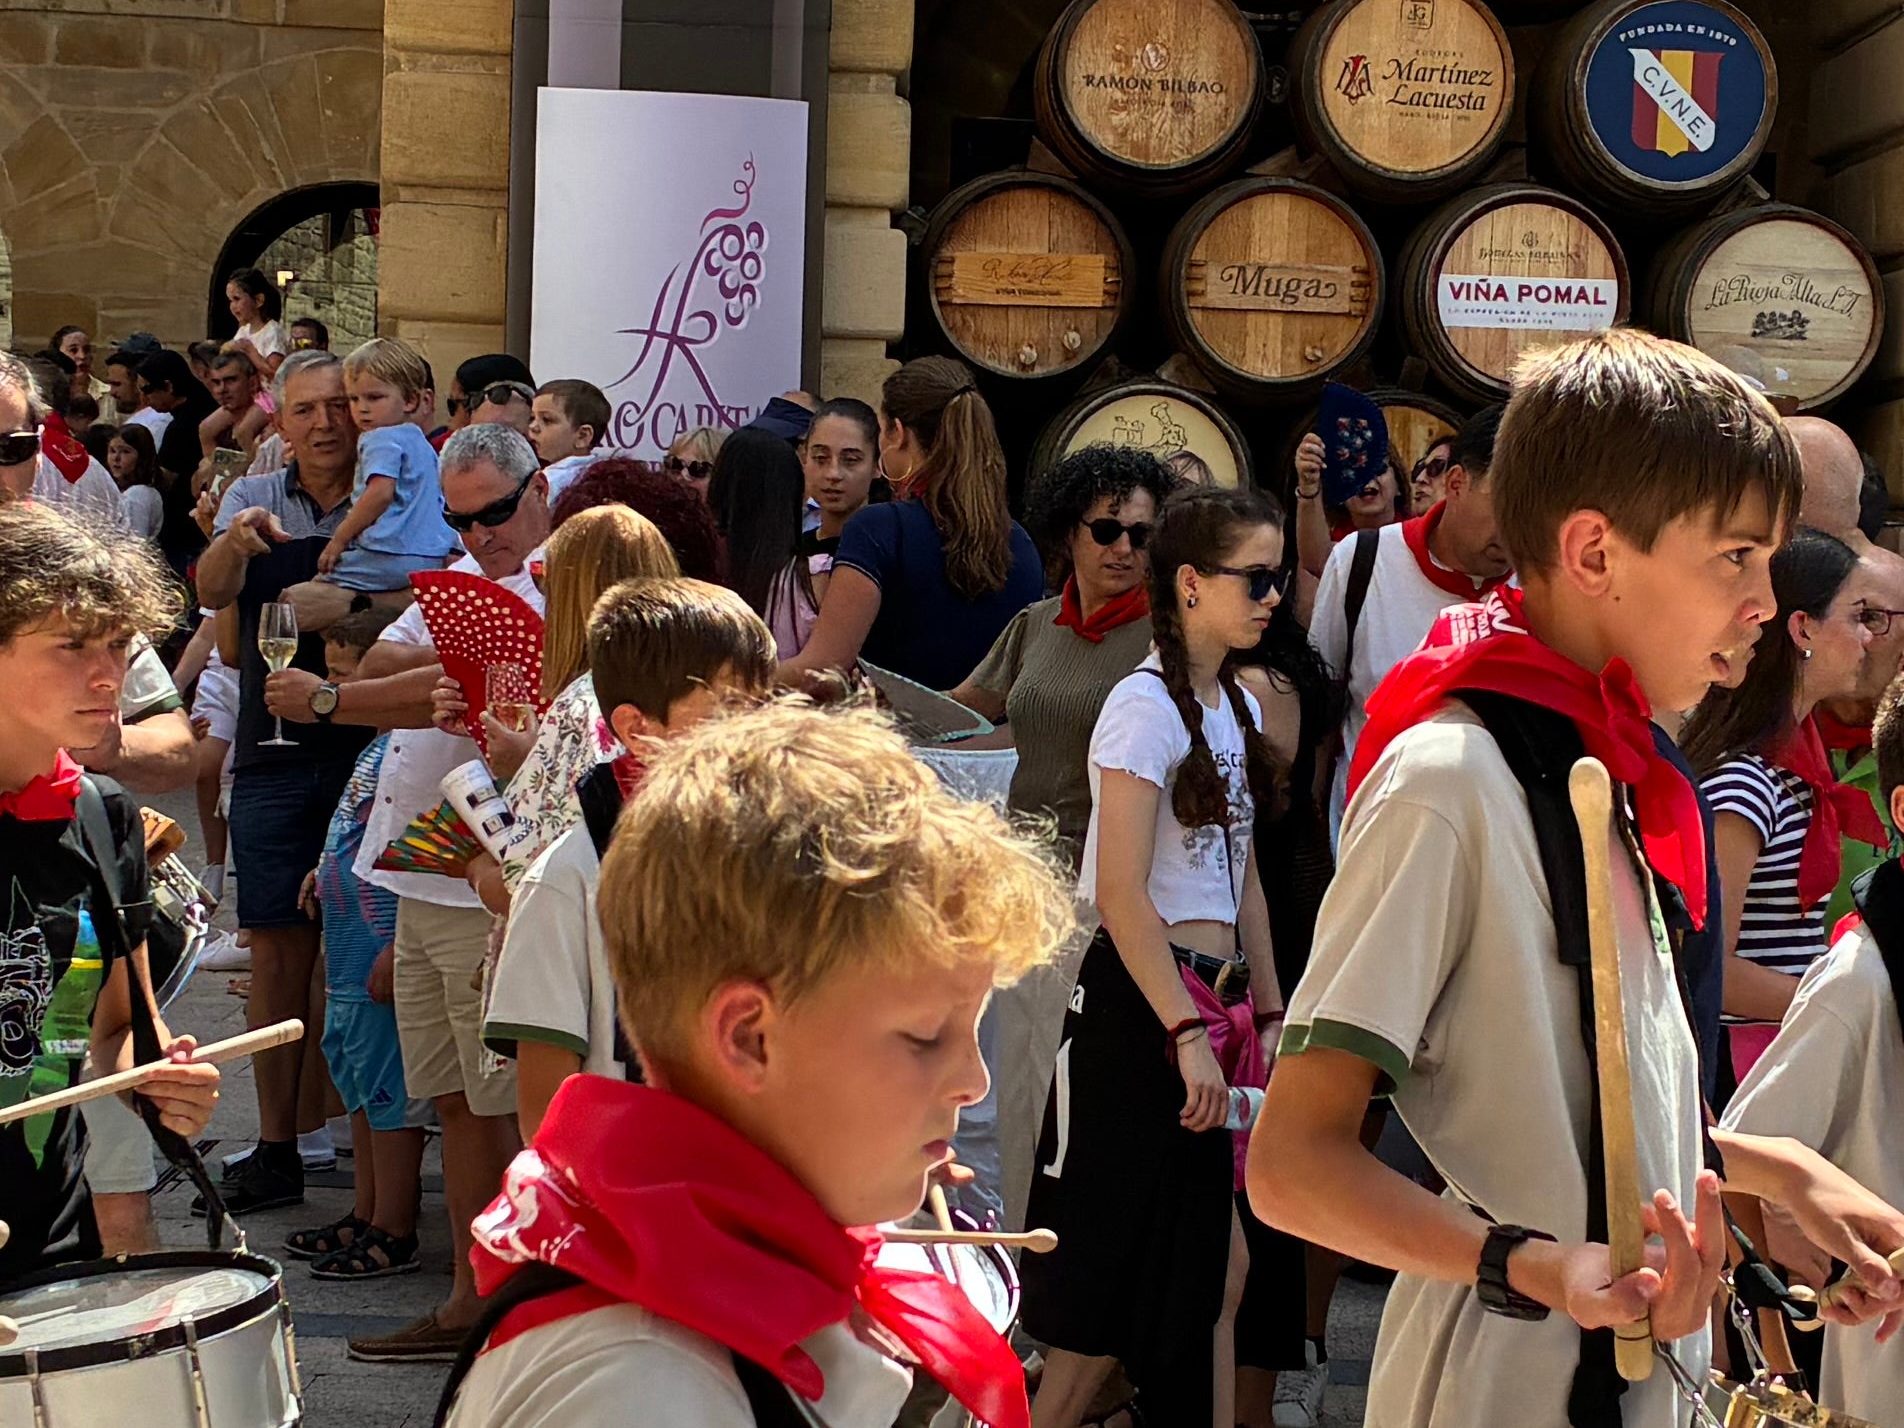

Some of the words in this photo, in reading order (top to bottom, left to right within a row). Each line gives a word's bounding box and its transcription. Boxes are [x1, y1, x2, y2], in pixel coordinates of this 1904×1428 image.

[1619, 23, 1683, 43] FUNDADA
[1687, 24, 1706, 35] EN
[1381, 57, 1494, 87] Martínez
[1156, 78, 1224, 95] BILBAO
[1385, 84, 1486, 111] Lacuesta
[1643, 66, 1707, 139] C.V.N.E.
[1219, 265, 1338, 305] Muga
[1449, 278, 1510, 303] VIÑA
[1517, 284, 1607, 305] POMAL
[1727, 274, 1780, 304] Rioja
